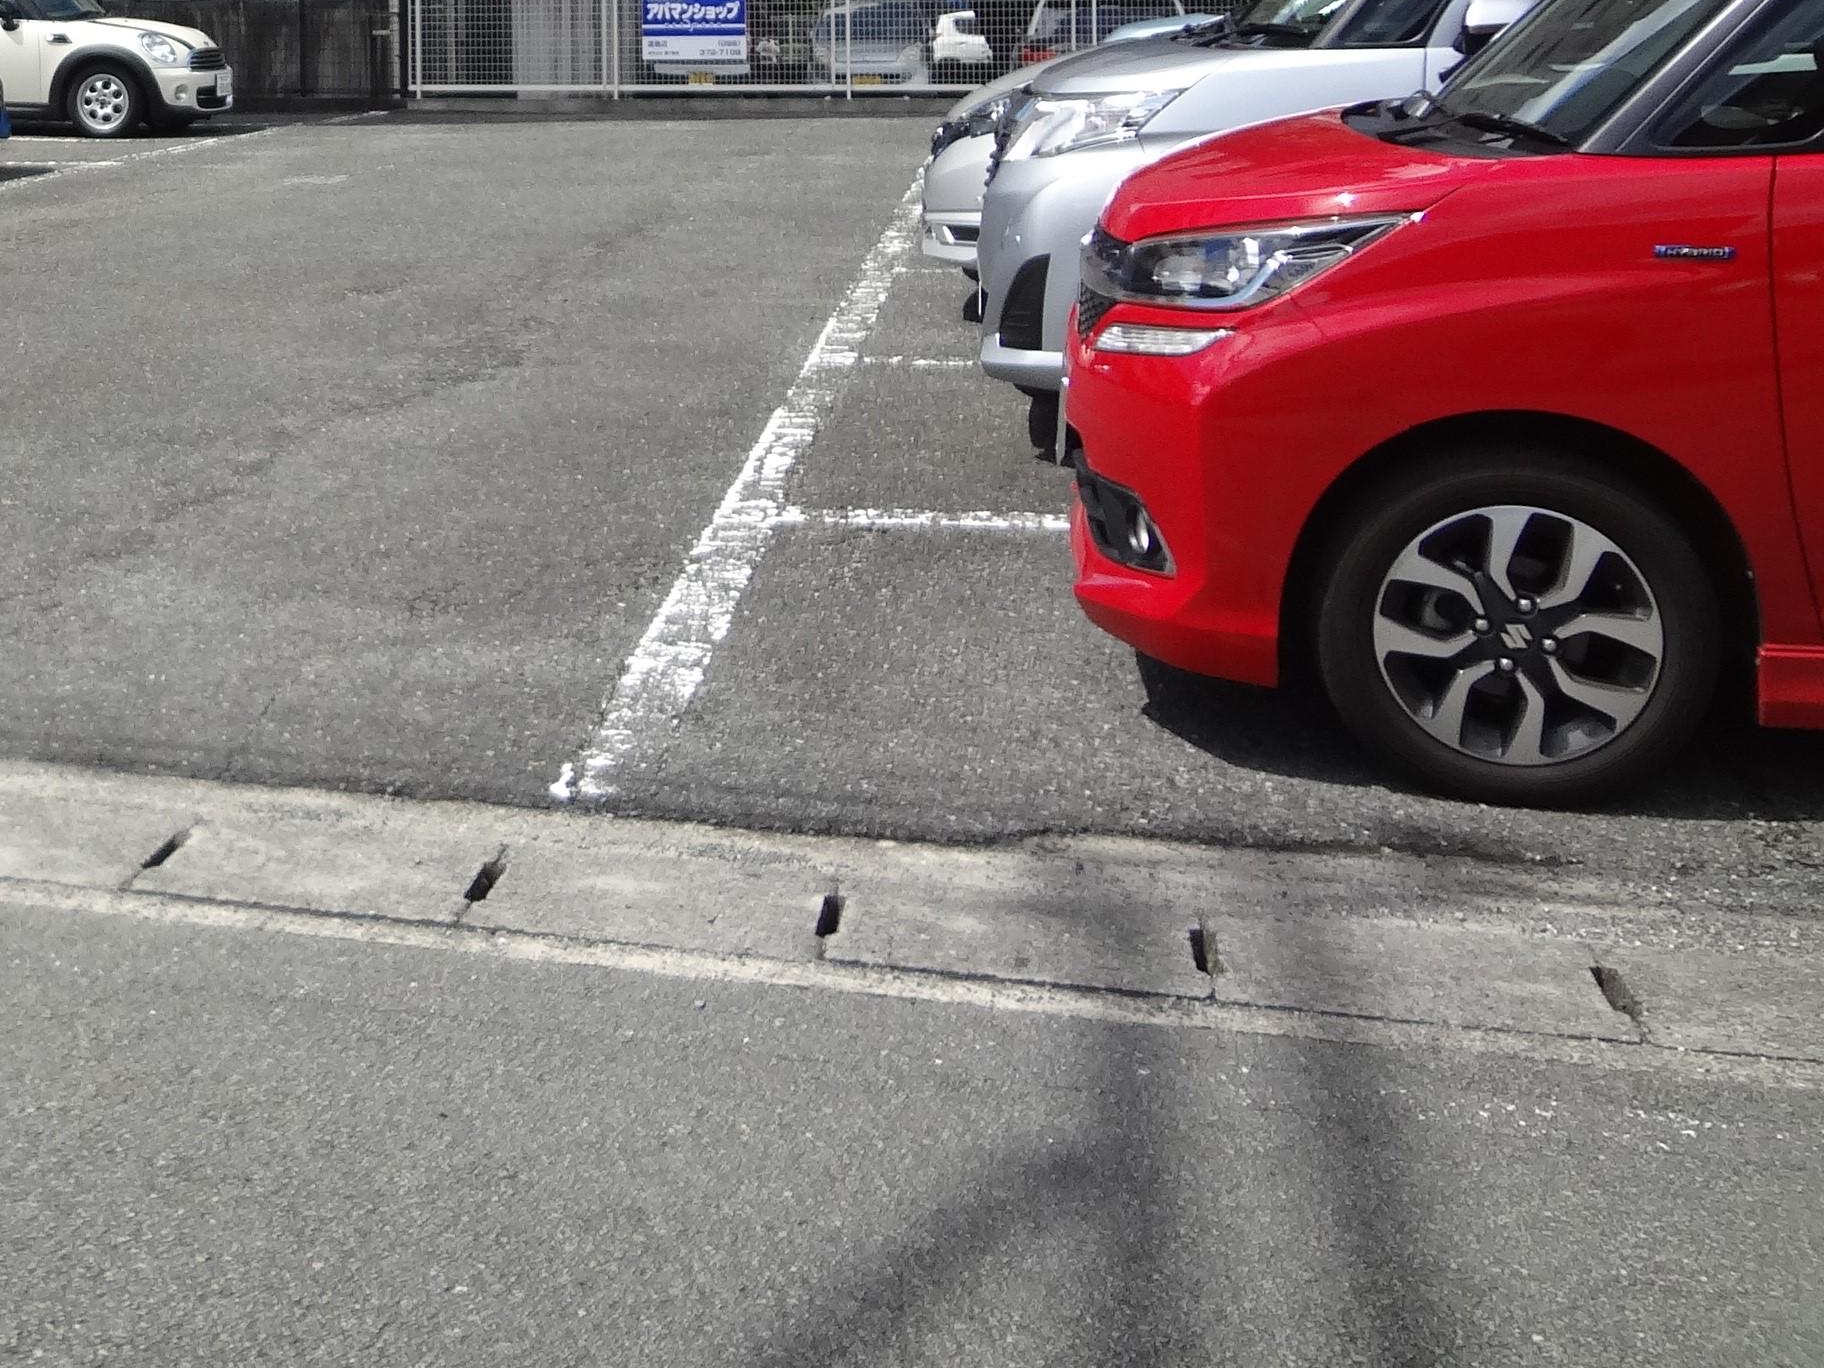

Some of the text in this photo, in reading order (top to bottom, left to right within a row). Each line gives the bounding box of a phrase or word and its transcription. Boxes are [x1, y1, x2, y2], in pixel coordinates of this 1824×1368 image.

[646, 1, 740, 20] アパマンショップ
